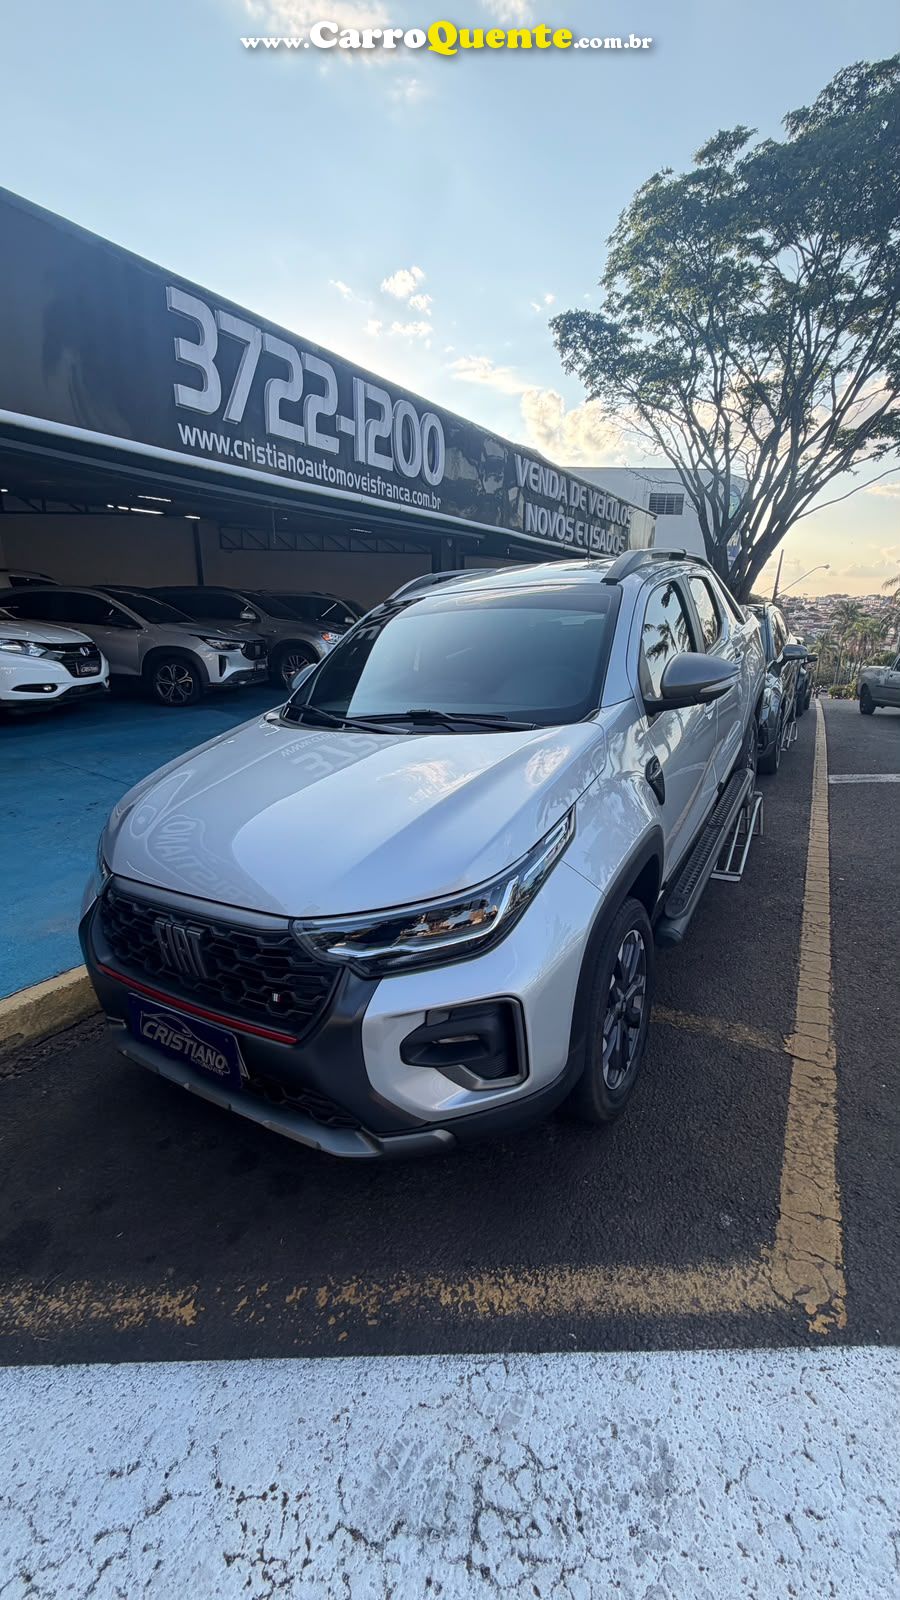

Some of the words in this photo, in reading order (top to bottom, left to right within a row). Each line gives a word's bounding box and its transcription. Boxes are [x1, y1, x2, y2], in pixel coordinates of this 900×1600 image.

[165, 286, 446, 486] 3722-1200
[177, 422, 442, 510] www.cristianoautomoveisfranca.com.br
[514, 454, 567, 503] VENDA
[569, 480, 587, 511] DE
[525, 502, 574, 543] NOVOS
[575, 523, 584, 545] E
[584, 525, 626, 556] USADOS
[152, 919, 208, 978] FIAT
[142, 1020, 226, 1070] CRISTIANO
